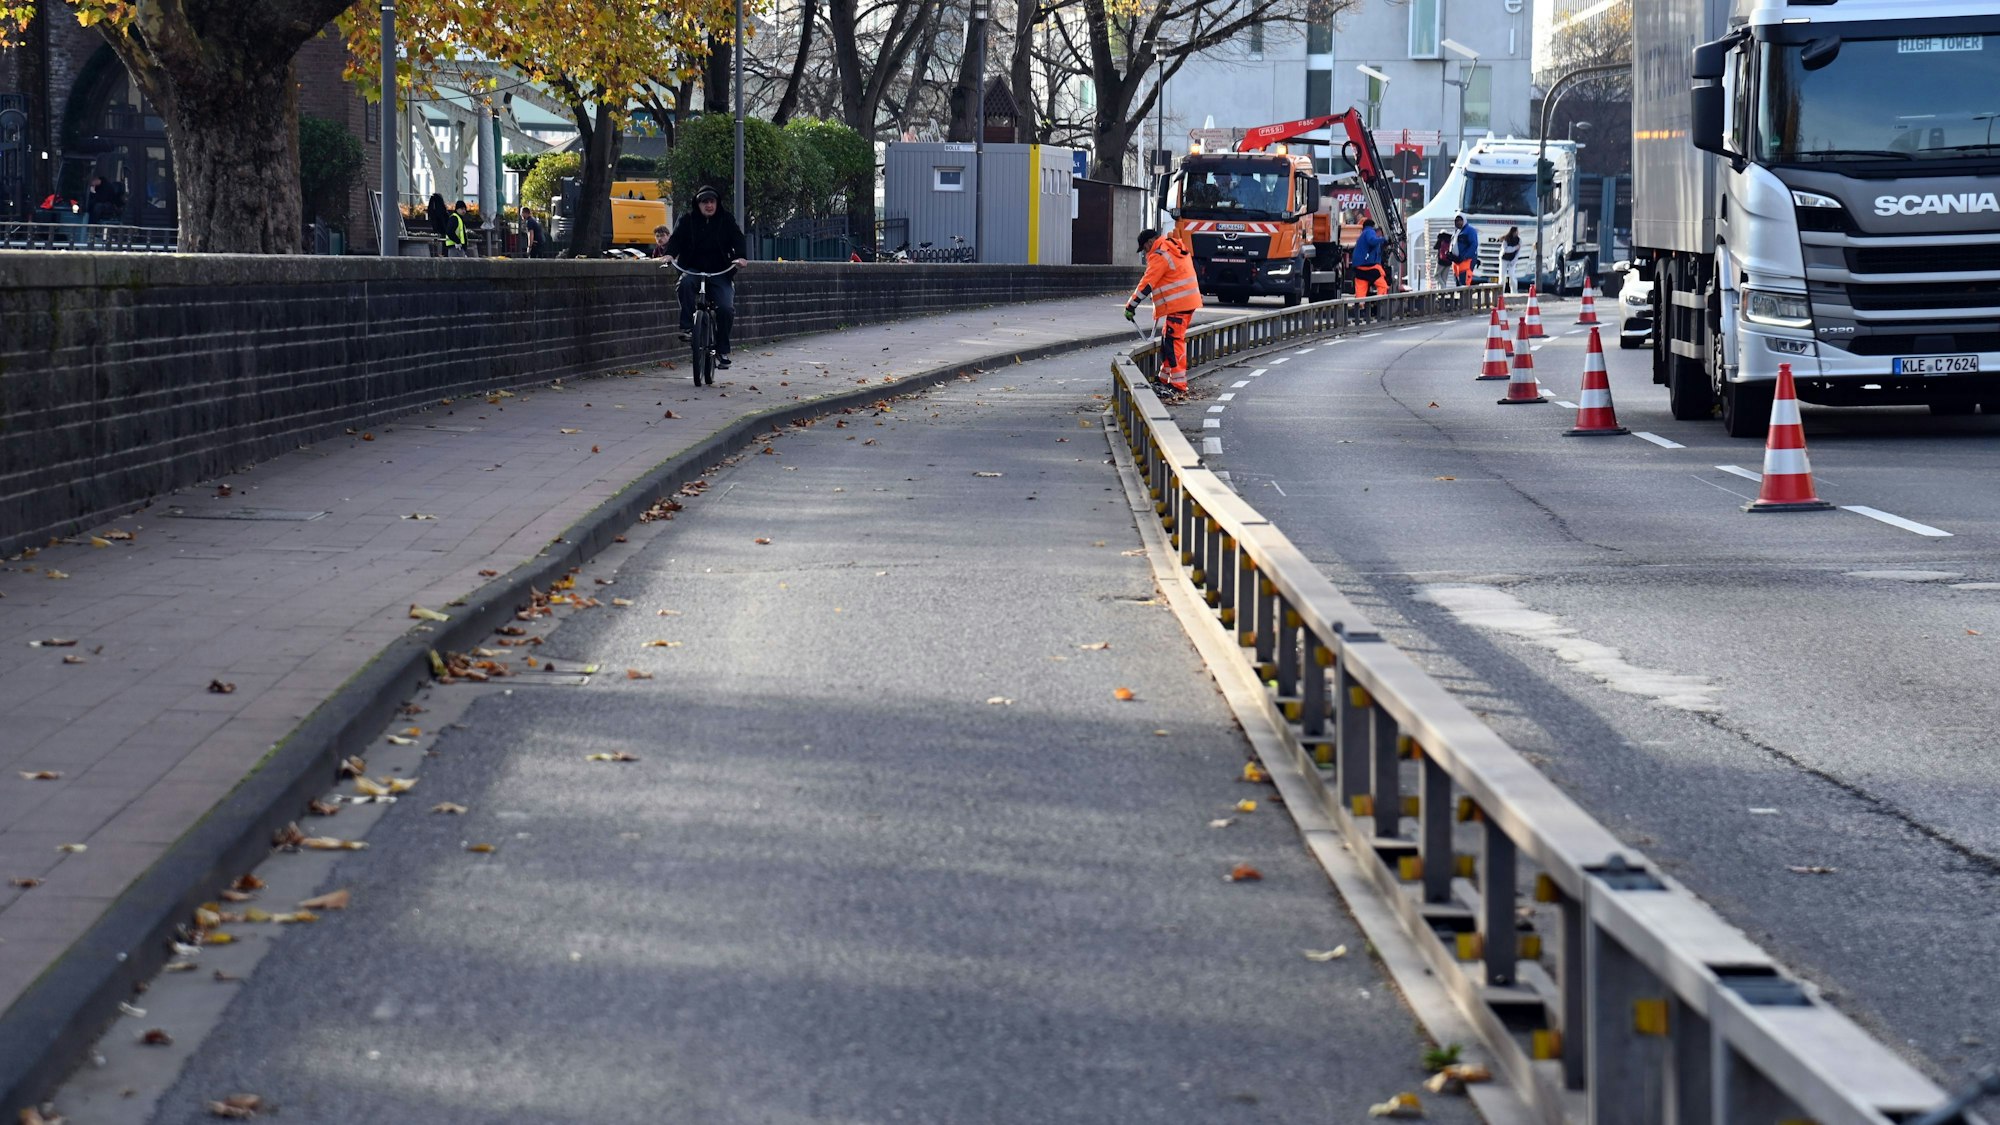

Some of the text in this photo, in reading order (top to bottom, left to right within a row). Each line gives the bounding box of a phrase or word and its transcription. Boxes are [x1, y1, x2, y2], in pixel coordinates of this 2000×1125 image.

[1901, 36, 1980, 51] HIGH-TOWER
[1260, 125, 1283, 135] FASSI
[1337, 193, 1350, 202] DE
[1874, 193, 2000, 216] SCANIA
[1902, 358, 1977, 373] KLE C 7624
